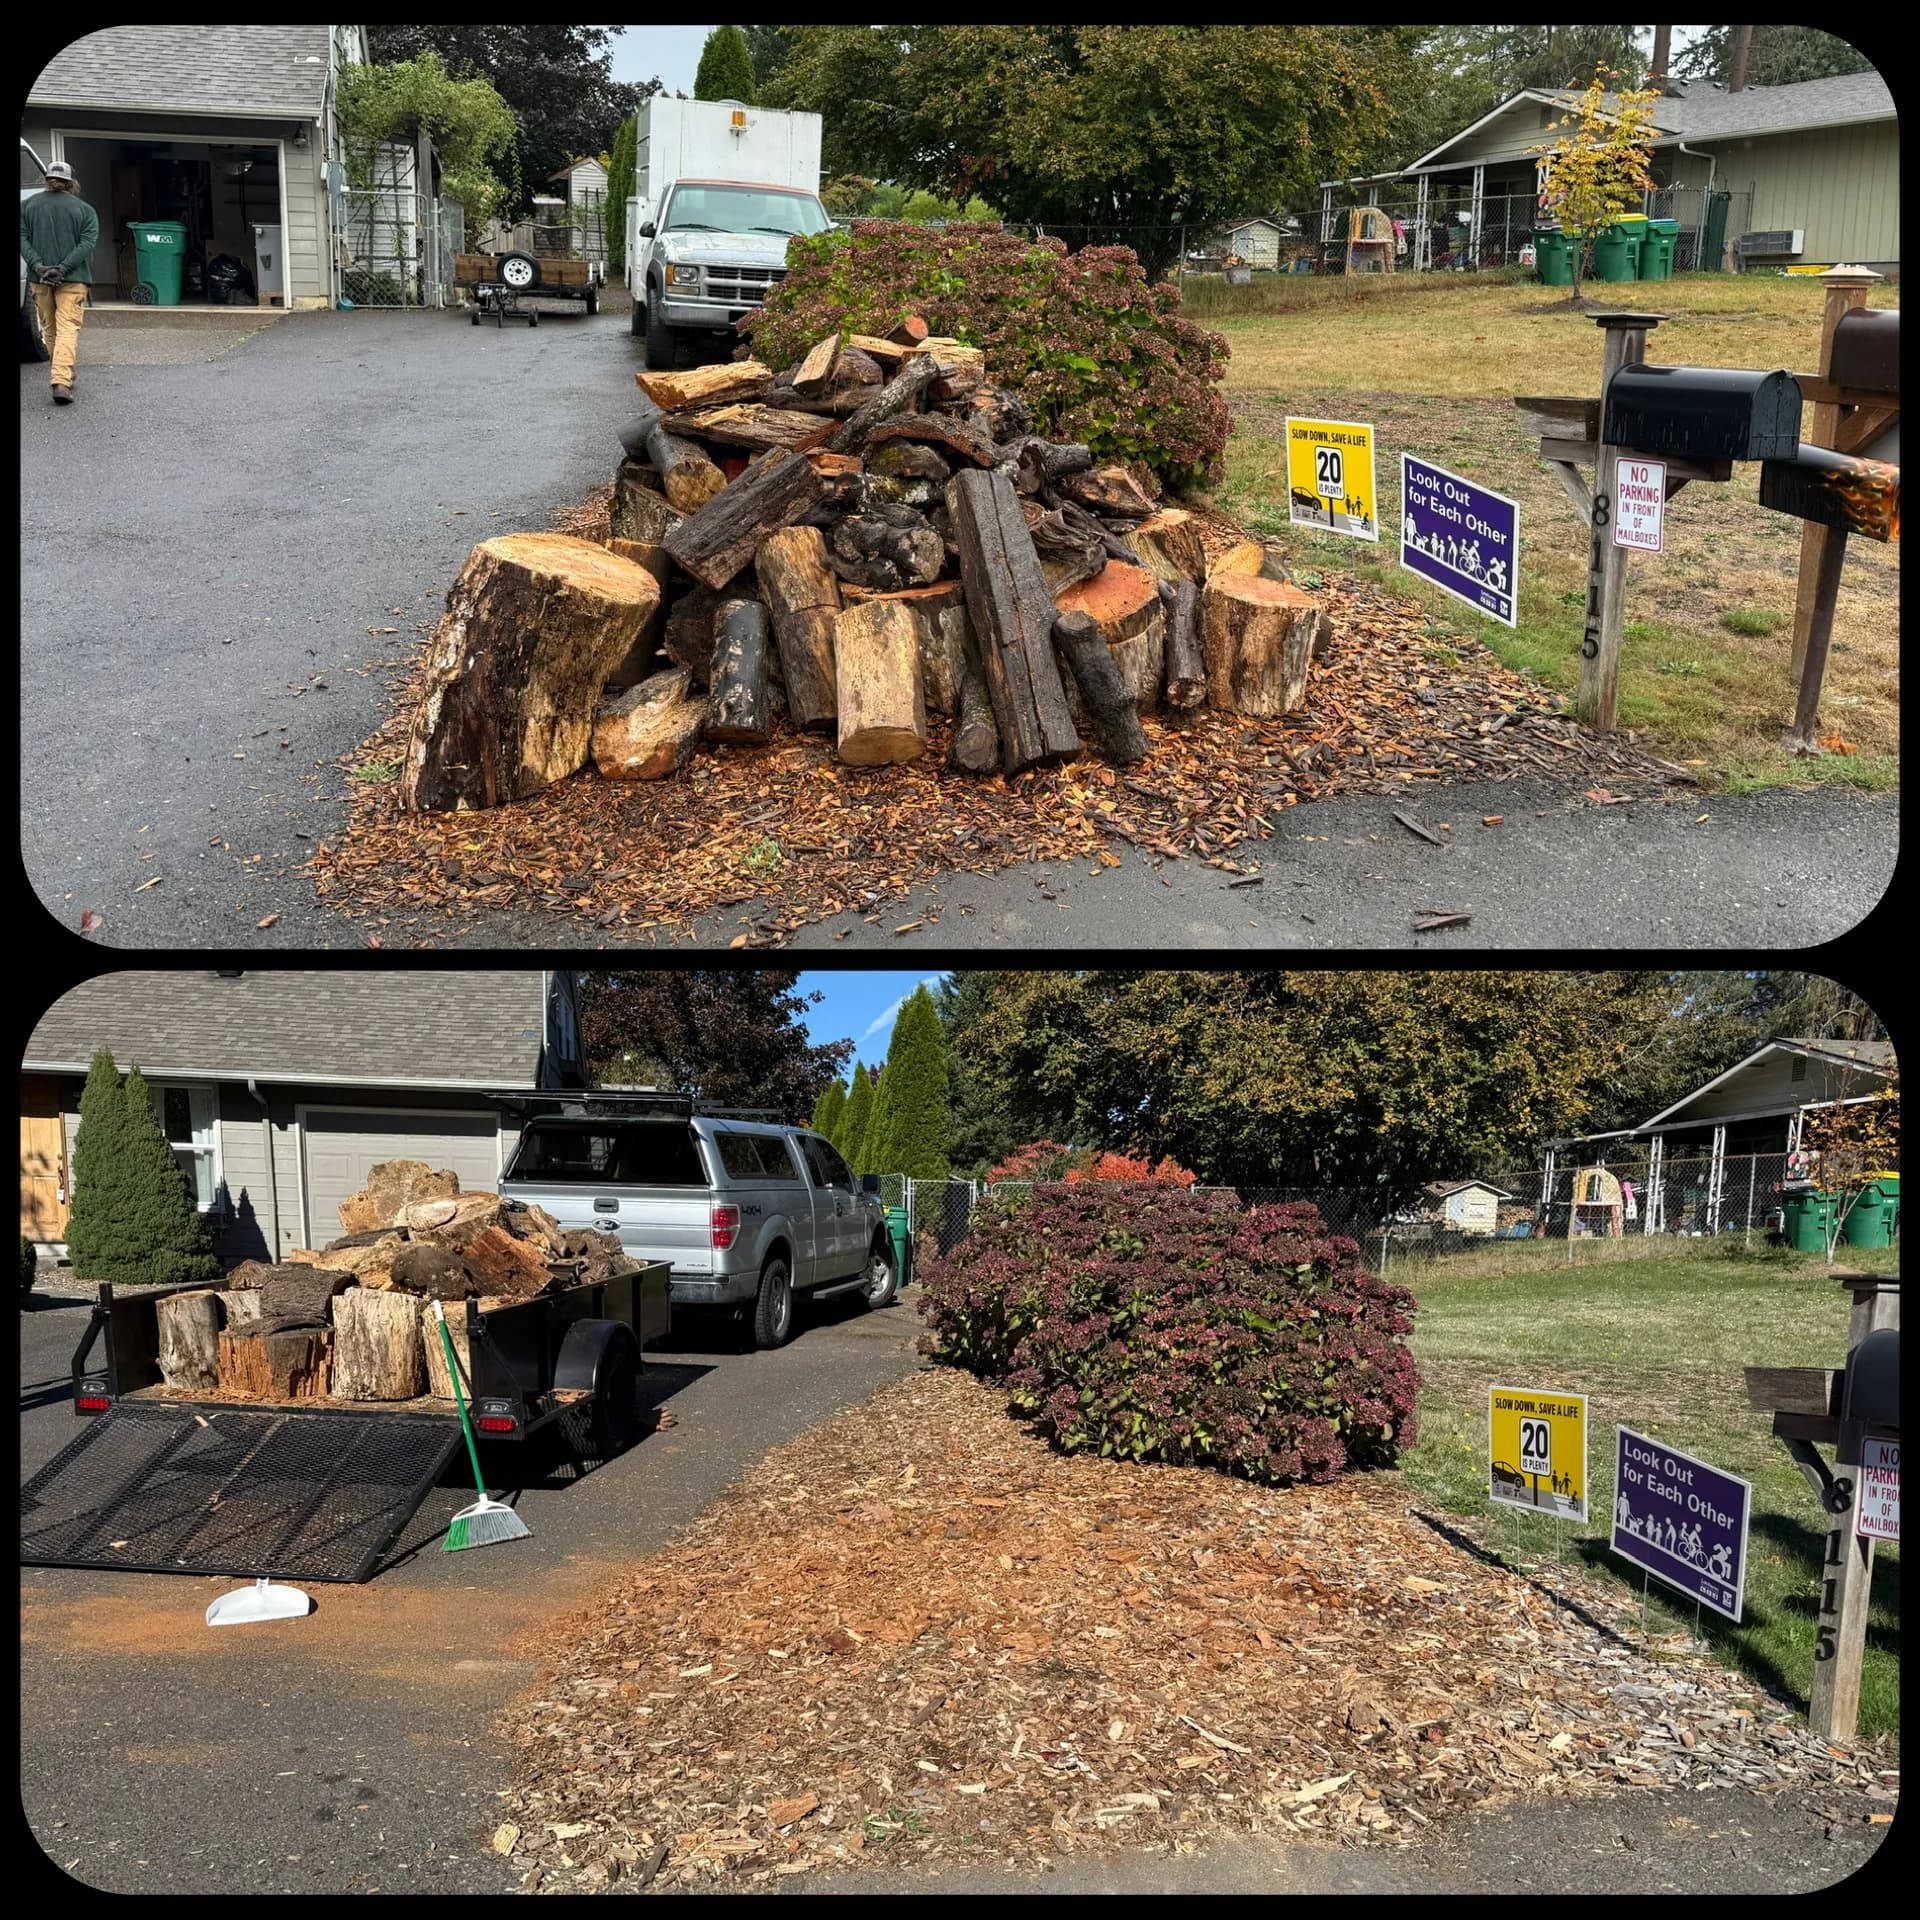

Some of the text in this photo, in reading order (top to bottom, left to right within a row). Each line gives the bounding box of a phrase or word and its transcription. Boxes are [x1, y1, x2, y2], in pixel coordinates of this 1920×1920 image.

[146, 234, 174, 244] WM
[1292, 428, 1367, 447] SLOW DOWN, SAVE A LIFE
[1317, 451, 1341, 483] 20
[1631, 466, 1648, 483] NO
[1319, 483, 1342, 497] IS PLENTY
[1409, 464, 1471, 507] Look Out
[1620, 483, 1660, 503] PARKING
[1408, 486, 1507, 546] for Each Other
[1622, 502, 1656, 518] IN FRONT
[1633, 517, 1643, 529] OF
[1617, 527, 1658, 545] MAILBOXES
[1495, 1397, 1579, 1419] SLOW DOWN, SAVE A LIFE
[1522, 1421, 1549, 1460] 20
[1624, 1439, 1694, 1487] Look Out
[1880, 1446, 1900, 1465] NO
[1522, 1458, 1549, 1473] IS PLENTY
[1866, 1464, 1900, 1487] PARKI
[1623, 1462, 1735, 1531] for Each Other
[1868, 1485, 1900, 1503] IN FRO
[1881, 1503, 1893, 1517] OF
